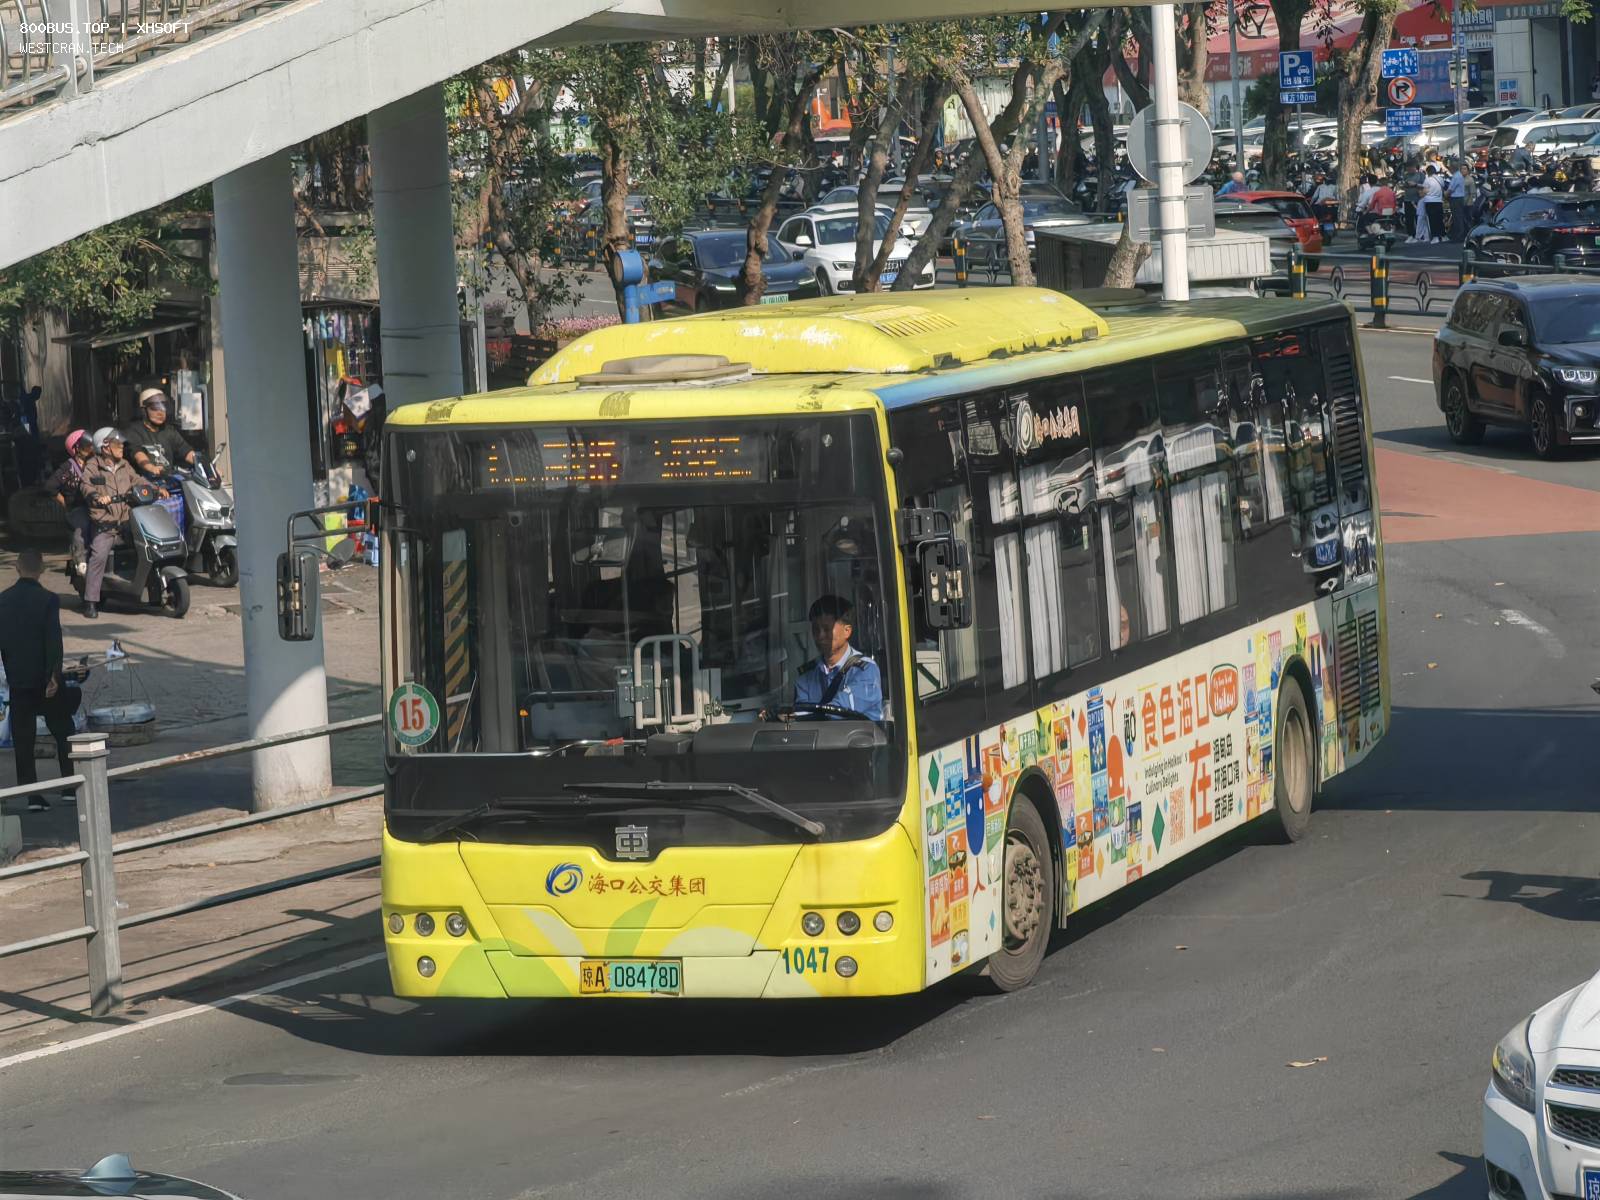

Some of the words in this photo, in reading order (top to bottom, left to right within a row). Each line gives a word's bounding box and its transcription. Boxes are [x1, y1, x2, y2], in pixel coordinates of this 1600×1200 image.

[1283, 54, 1300, 76] P
[399, 698, 425, 731] 15
[1141, 672, 1210, 752] 食色海口
[1188, 739, 1213, 834] 在
[588, 873, 706, 897] 海口公交集团
[782, 946, 830, 975] 1047
[614, 965, 679, 988] 08478D
